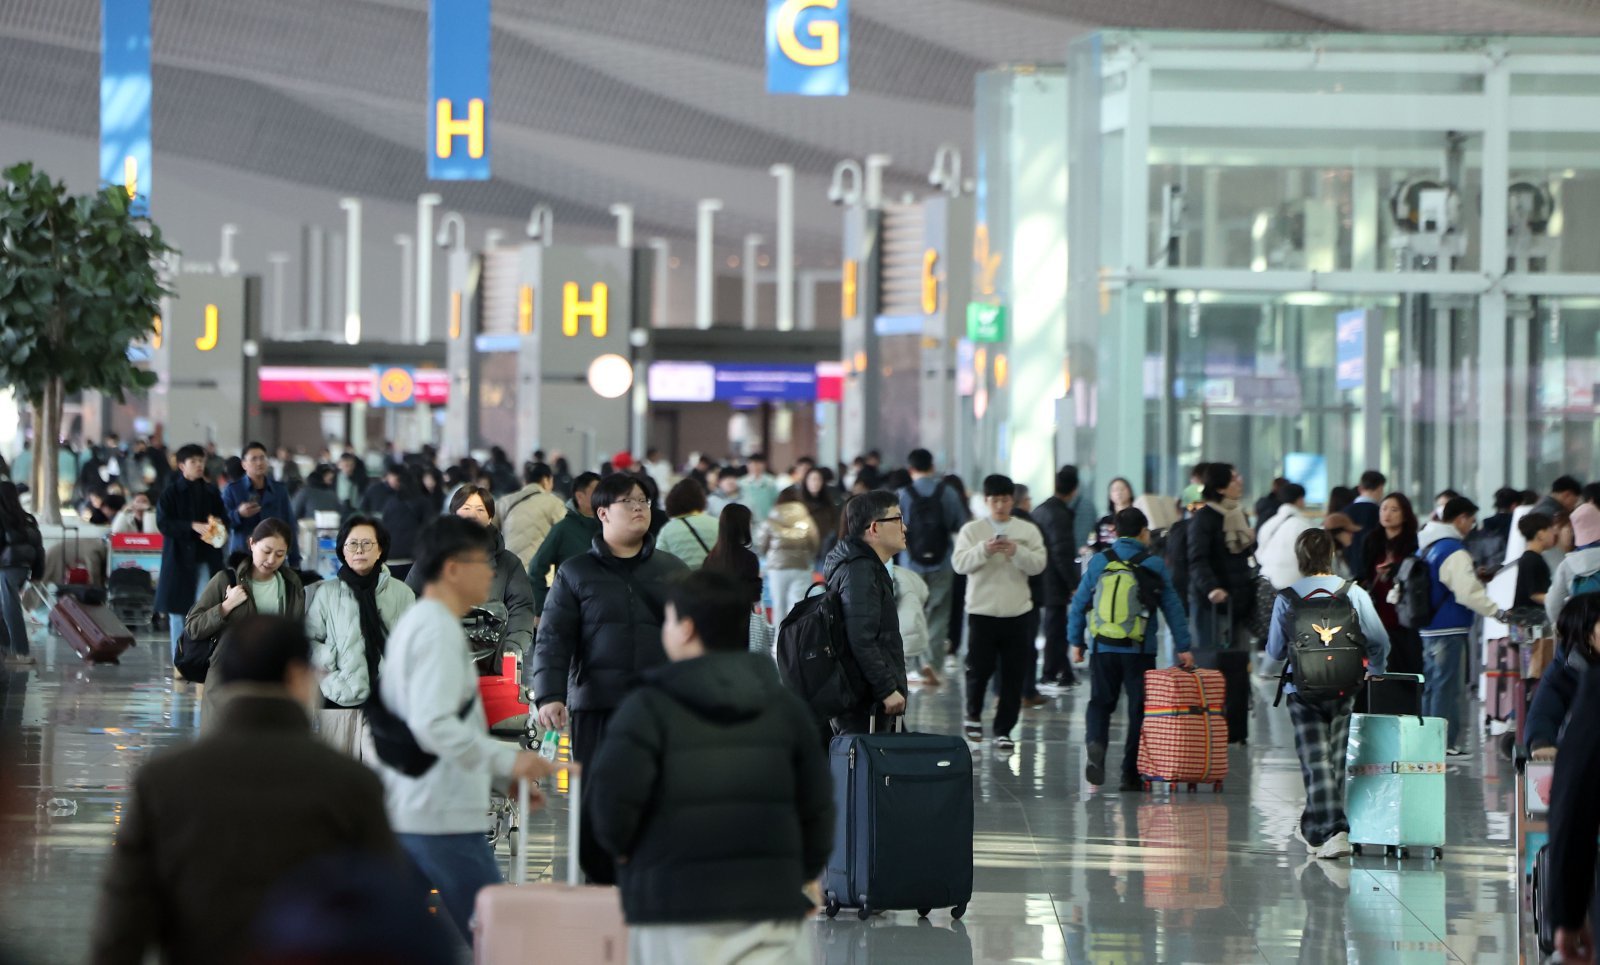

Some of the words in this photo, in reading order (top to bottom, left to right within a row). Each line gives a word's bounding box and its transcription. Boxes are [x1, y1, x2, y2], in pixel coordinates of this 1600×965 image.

[778, 0, 840, 67] G
[436, 98, 484, 159] H
[195, 303, 219, 351] J
[562, 281, 608, 337] H
